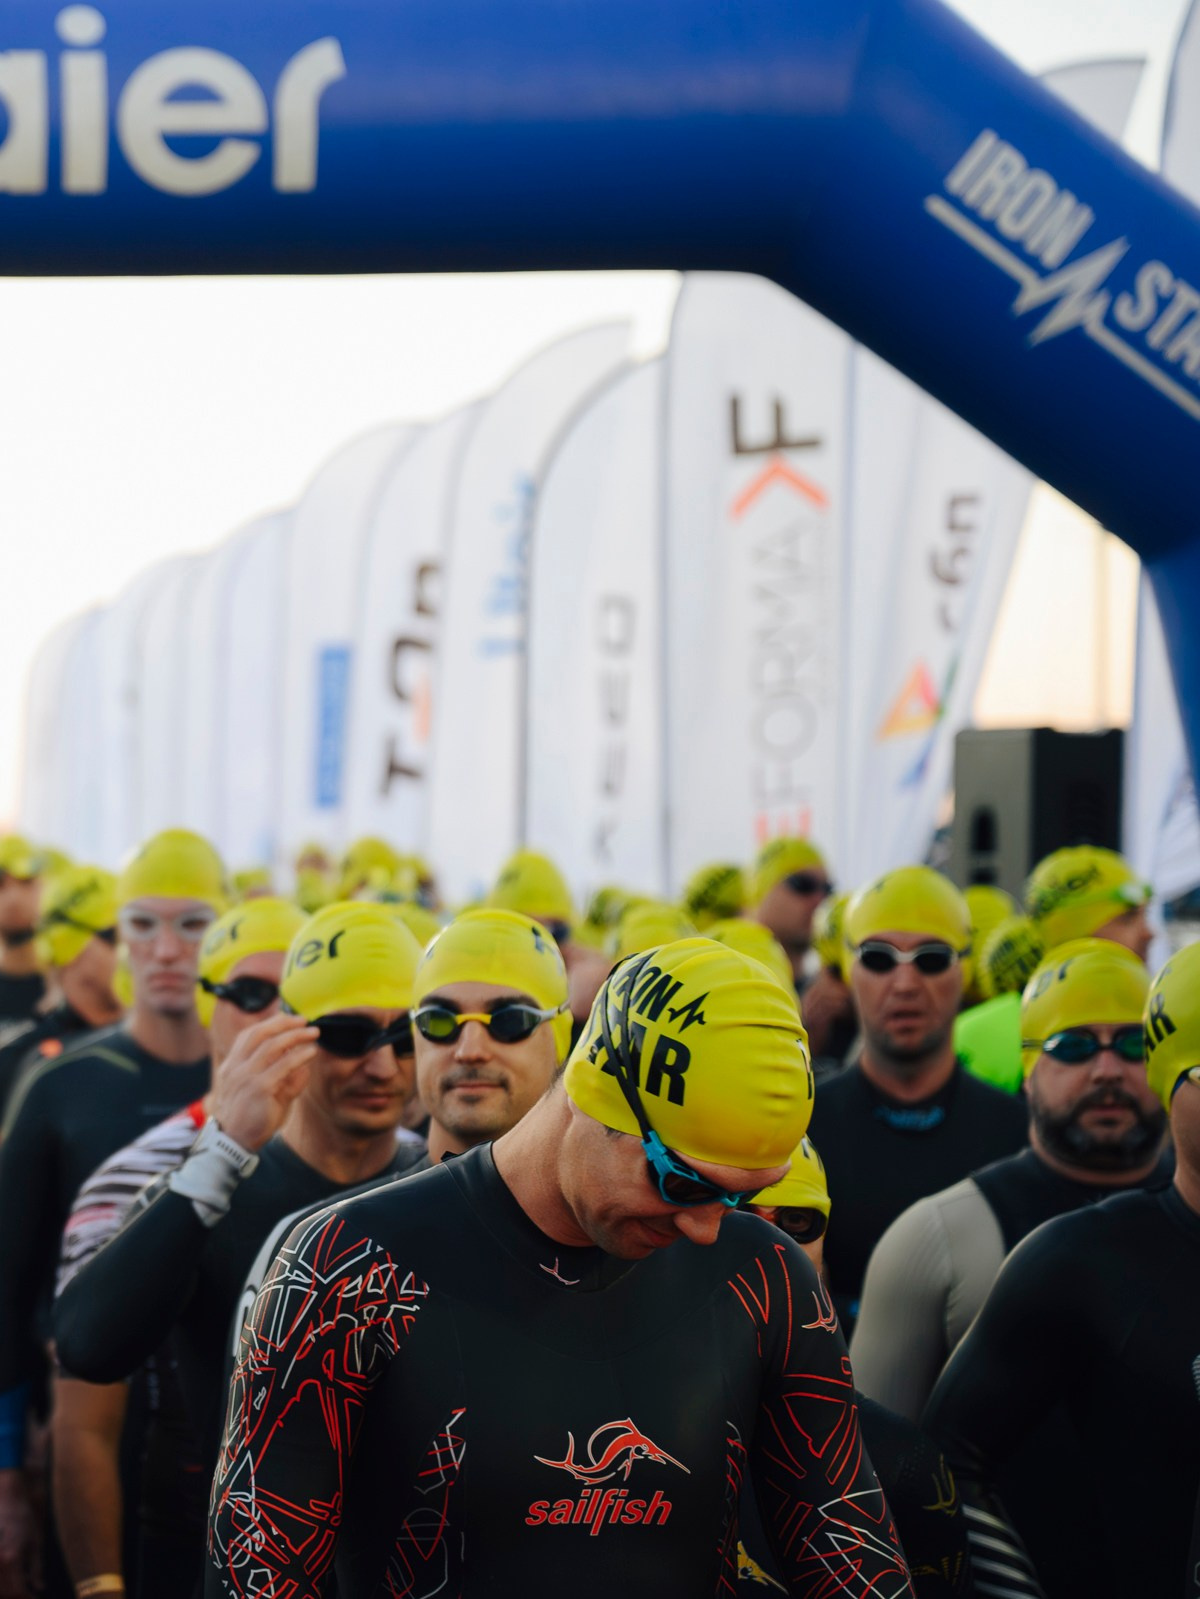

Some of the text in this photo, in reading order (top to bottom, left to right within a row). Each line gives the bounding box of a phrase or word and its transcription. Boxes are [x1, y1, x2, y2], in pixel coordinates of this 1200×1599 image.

[943, 128, 1096, 270] IRON
[1113, 259, 1200, 391] STA
[525, 1488, 673, 1536] sailfish
